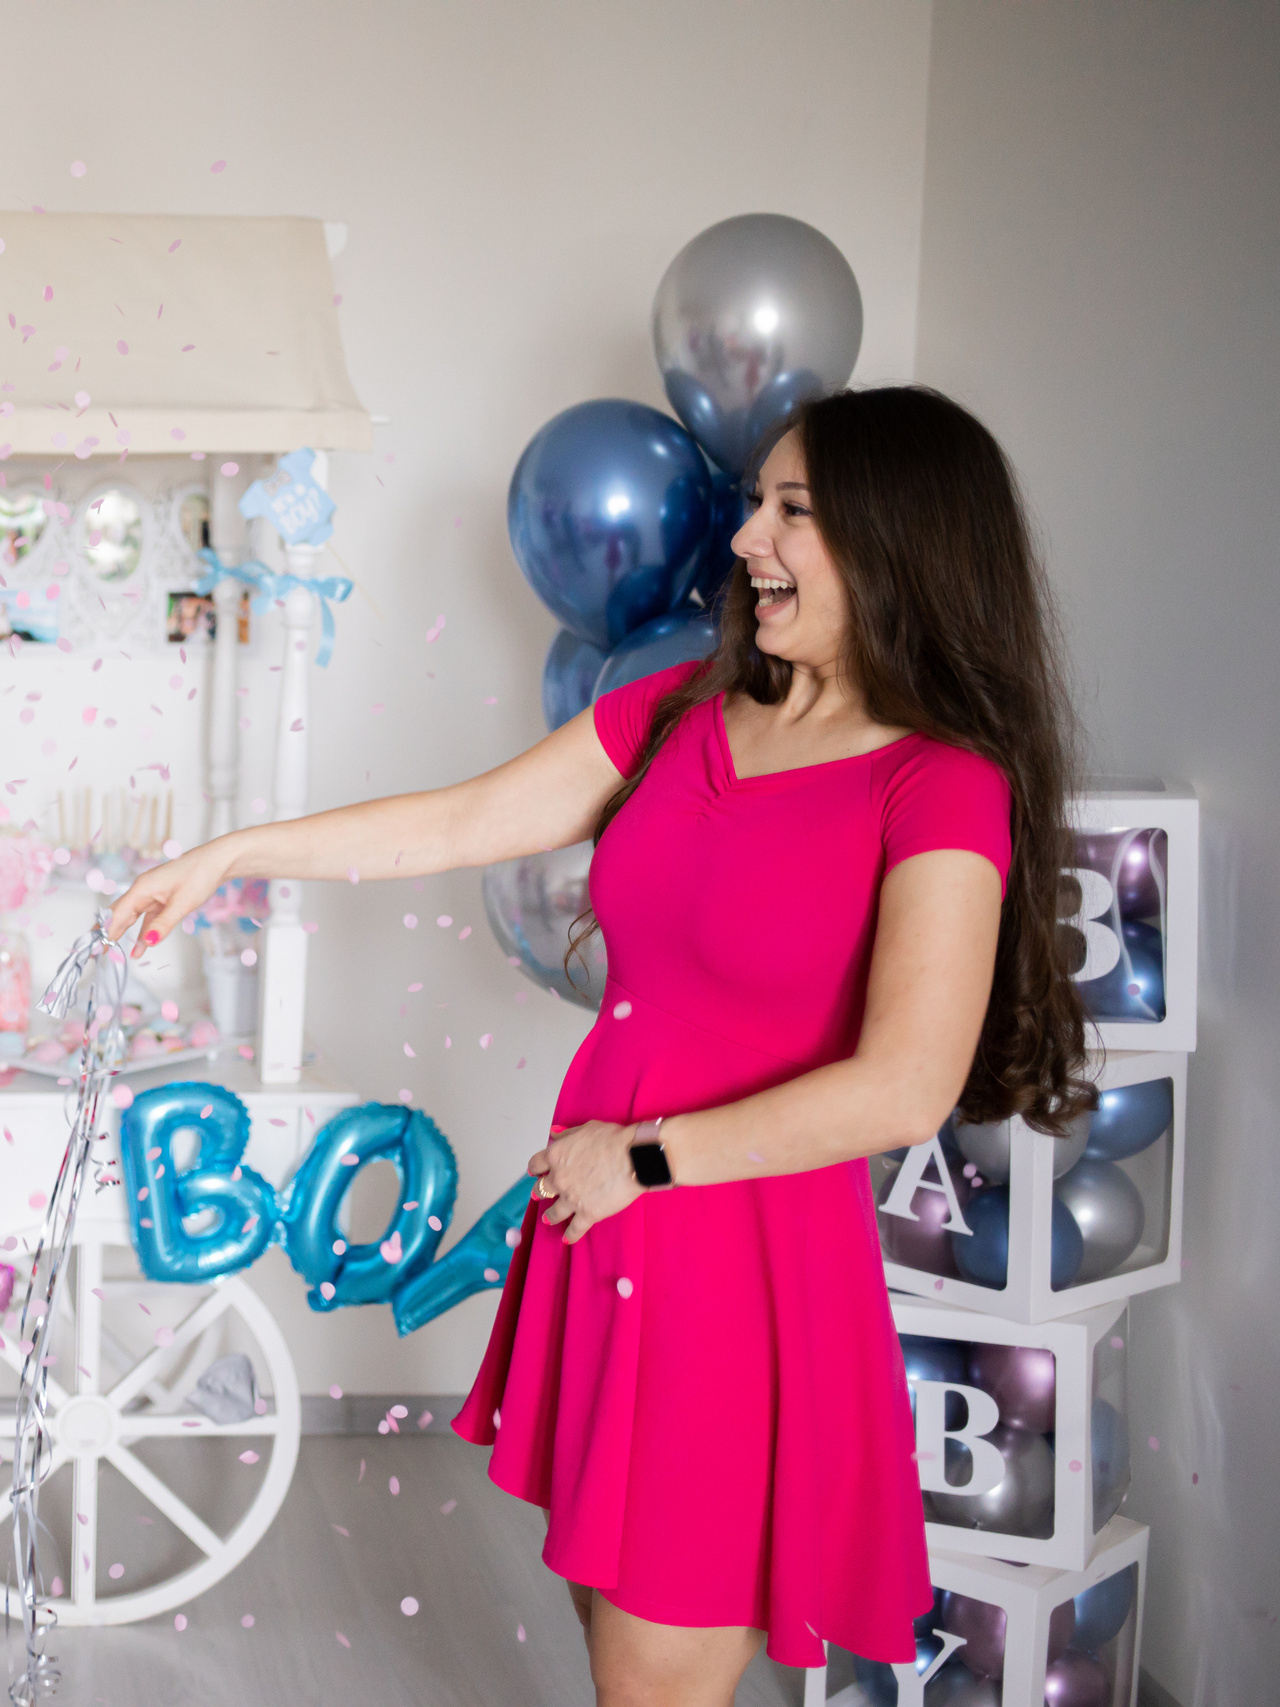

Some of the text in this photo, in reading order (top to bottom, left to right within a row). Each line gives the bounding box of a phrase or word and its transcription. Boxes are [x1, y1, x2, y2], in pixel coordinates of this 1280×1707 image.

[1056, 867, 1121, 982] B
[878, 1133, 974, 1236] A
[907, 1378, 1006, 1496] B
